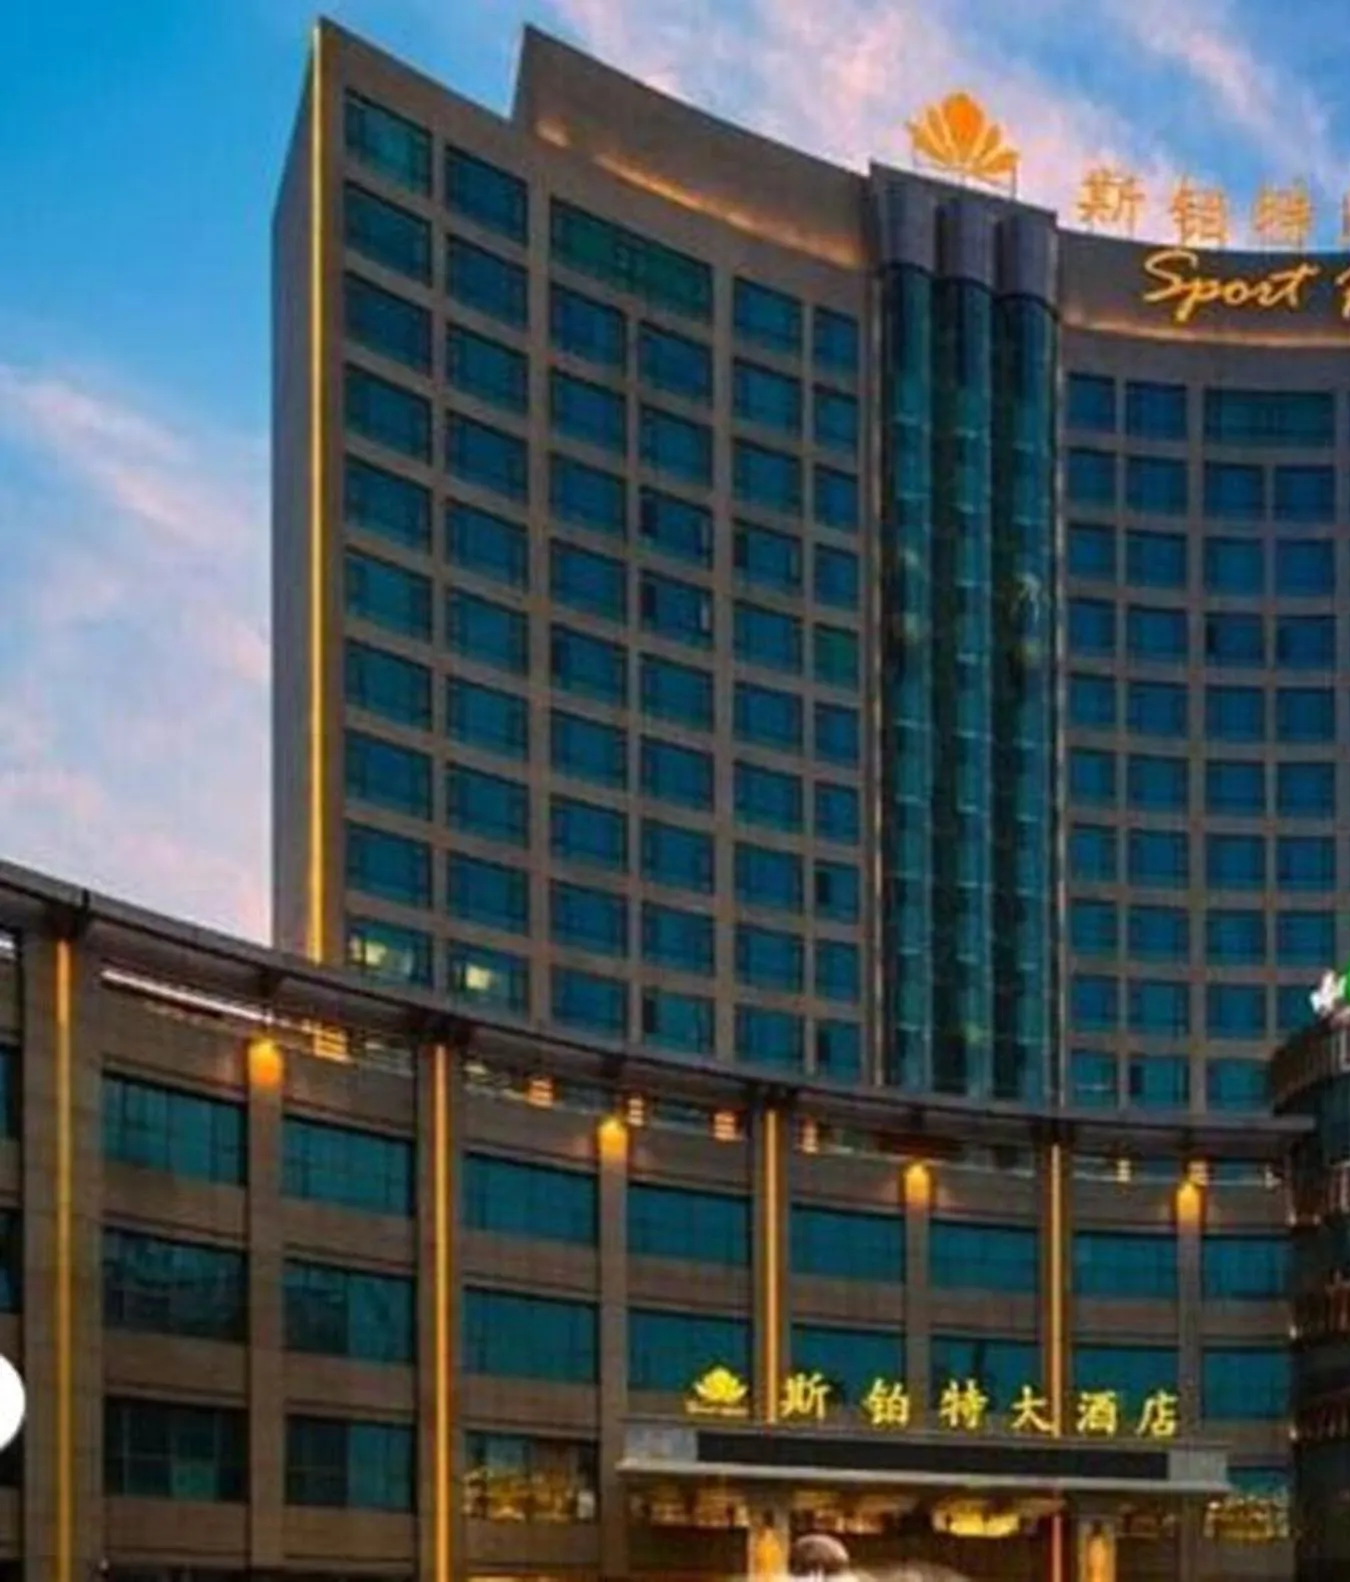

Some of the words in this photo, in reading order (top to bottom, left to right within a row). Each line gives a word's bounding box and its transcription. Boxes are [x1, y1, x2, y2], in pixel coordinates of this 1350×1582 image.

[1143, 249, 1320, 321] Sport
[781, 1371, 1178, 1437] 斯铂特大酒店
